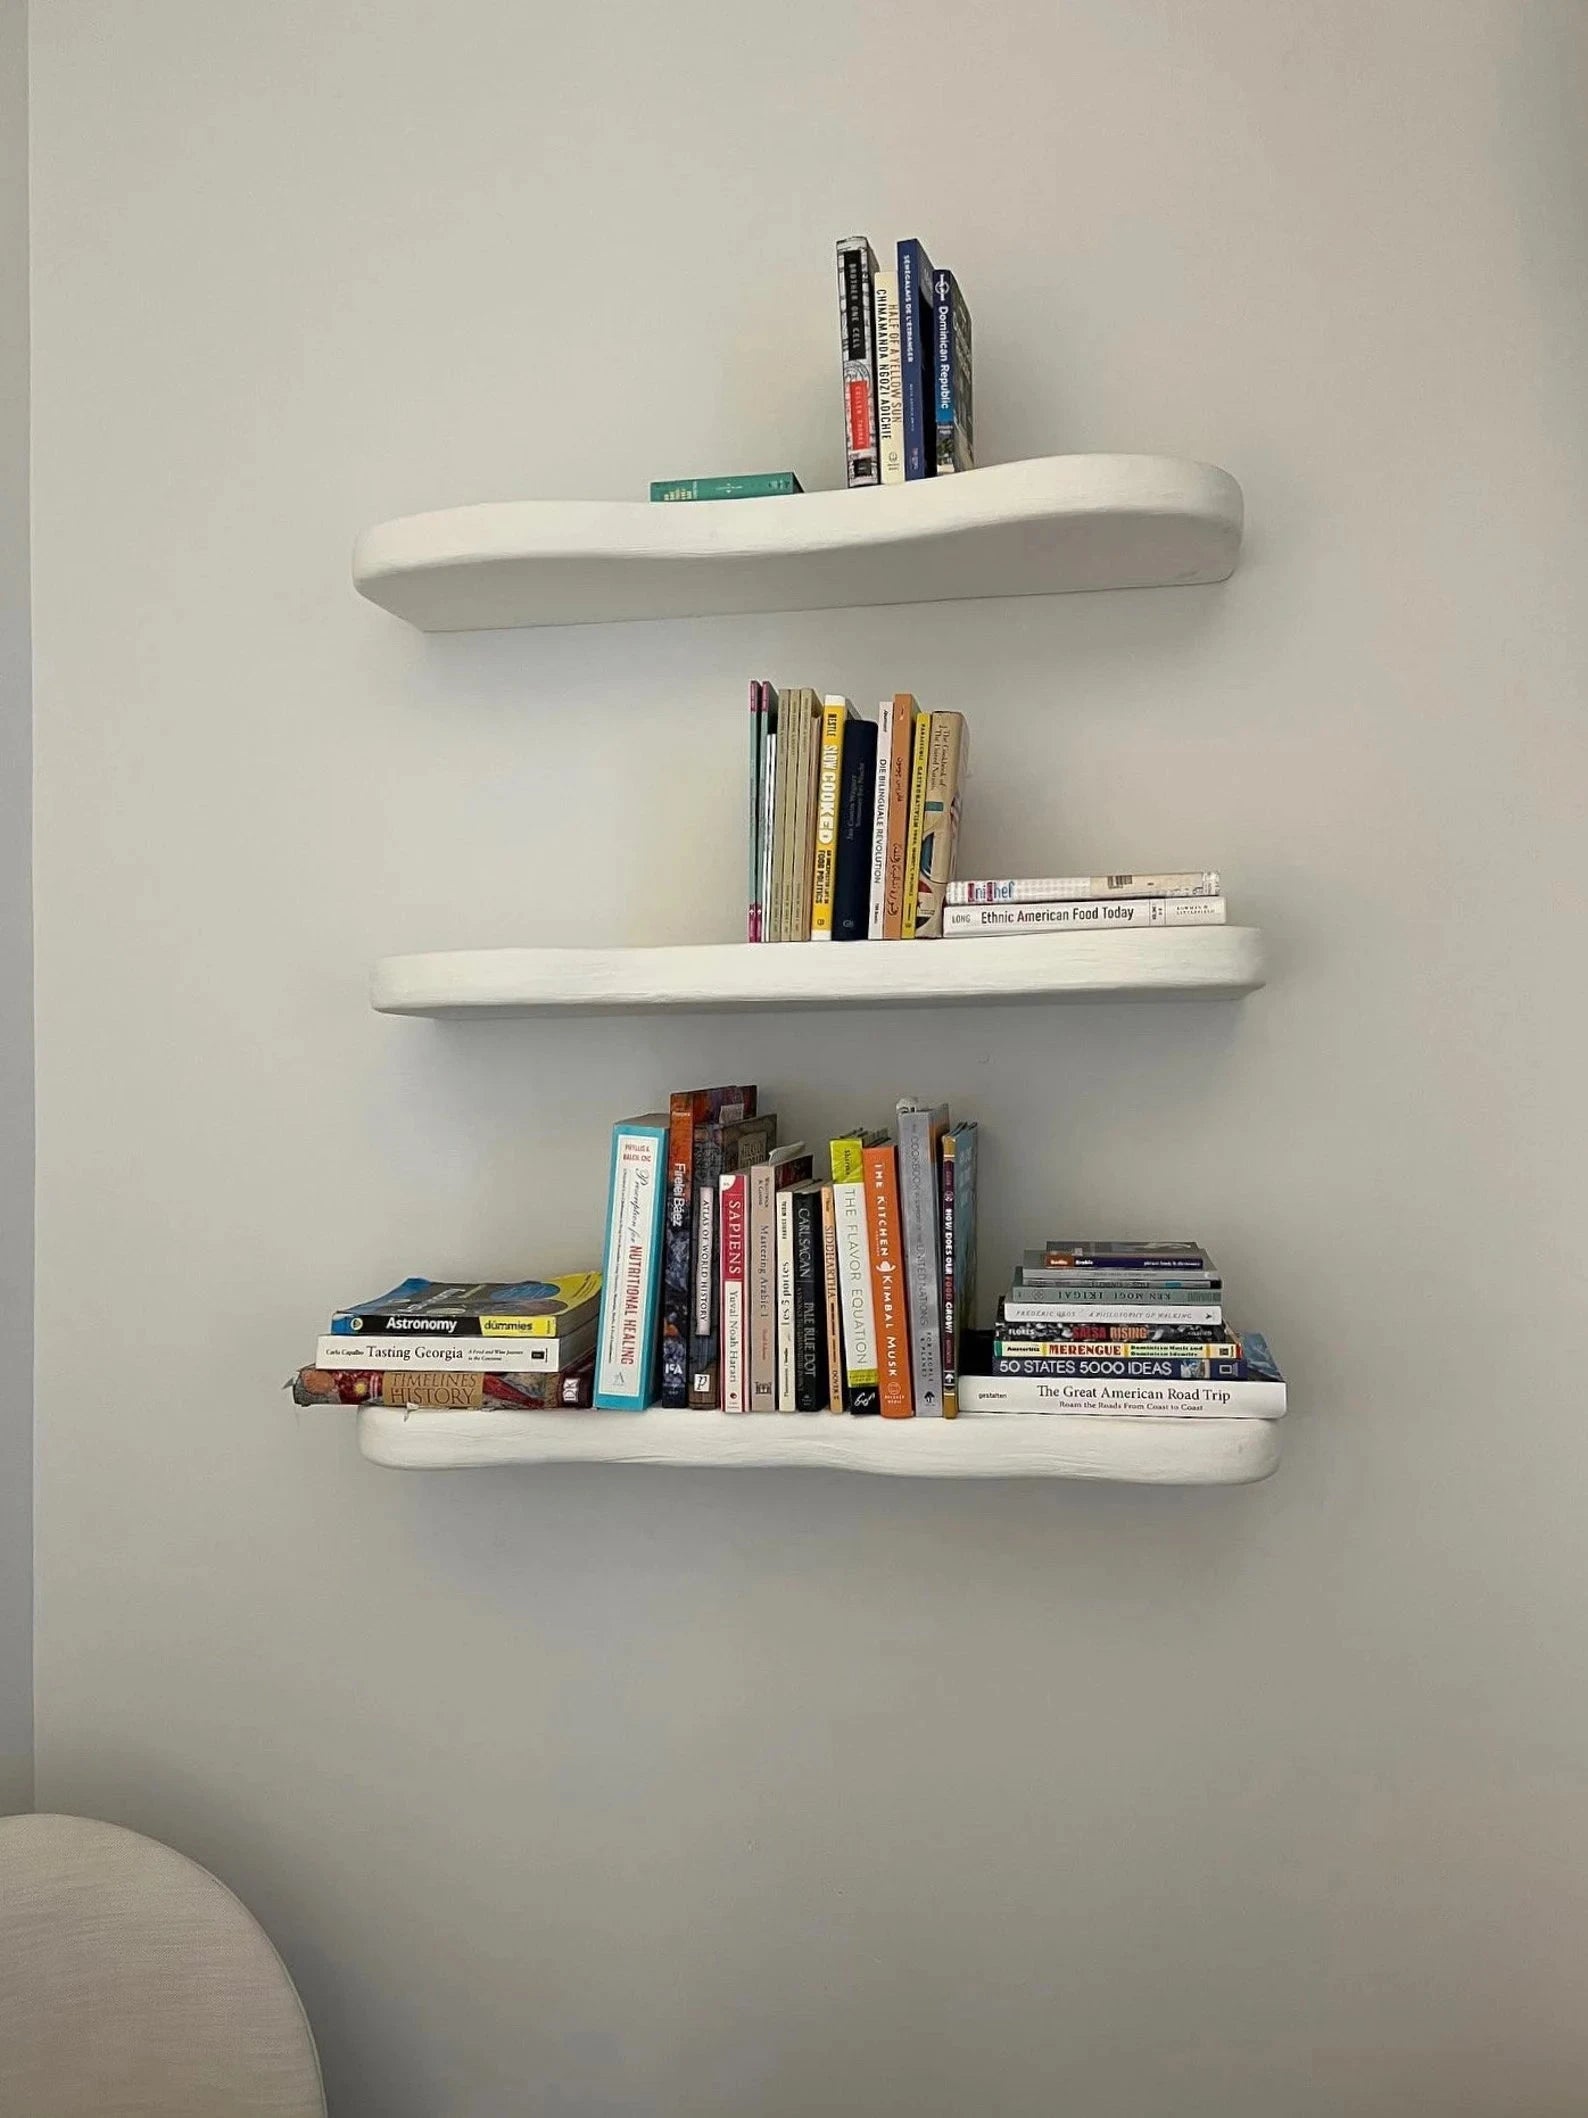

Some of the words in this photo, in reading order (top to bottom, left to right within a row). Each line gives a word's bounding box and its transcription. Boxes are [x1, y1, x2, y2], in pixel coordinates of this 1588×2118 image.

[851, 305, 859, 322] ONE
[876, 289, 888, 359] CHIMAMANDA
[888, 304, 899, 327] HALF
[852, 327, 860, 348] CELL
[889, 332, 899, 344] OF
[939, 306, 949, 361] Dominican
[879, 364, 890, 395] NGOZI
[890, 358, 901, 398] YELLOW
[939, 364, 950, 409] Republic
[880, 399, 891, 439] ADICHIE
[891, 402, 902, 423] SUN
[827, 714, 837, 736] NESTLE
[934, 730, 942, 742] The
[942, 730, 951, 742] The
[823, 745, 838, 770] SLOW
[879, 759, 887, 773] DIE
[932, 744, 941, 764] United
[940, 744, 950, 776] Cookbook
[819, 771, 836, 844] COOKED
[876, 776, 886, 826] BILINGUALE
[818, 850, 826, 869] FOOD
[874, 829, 884, 883] REVOLUTION
[815, 870, 825, 903] POLITICS
[952, 914, 971, 924] LONG
[981, 910, 1014, 924] Ethnic
[1017, 908, 1069, 923] American
[1073, 906, 1099, 921] Food
[1102, 905, 1134, 921] Today
[910, 1135, 921, 1190] COOKBOOK
[673, 1163, 686, 1196] Firelei
[874, 1163, 884, 1188] THE
[630, 1168, 649, 1227] Prescription
[845, 1189, 857, 1217] THE
[672, 1198, 686, 1226] Báez
[702, 1199, 710, 1226] ATLAS
[798, 1208, 810, 1236] CARL
[945, 1208, 953, 1230] HOW
[628, 1228, 641, 1243] for
[702, 1229, 710, 1241] OF
[728, 1200, 741, 1274] SAPIENS
[877, 1196, 889, 1256] KITCHEN
[758, 1225, 769, 1274] Mastering
[847, 1225, 864, 1280] FLAVOR
[945, 1232, 953, 1255] DOES
[701, 1244, 709, 1278] WORLD
[799, 1238, 811, 1278] SAGAN
[825, 1225, 836, 1299] SIDDHARTHA
[916, 1245, 927, 1281] UNITED
[945, 1257, 953, 1274] OUR
[624, 1245, 643, 1315] NUTRITIONAL
[781, 1261, 791, 1297] portes
[945, 1276, 953, 1300] FOOD
[700, 1281, 708, 1322] HISTORY
[729, 1290, 739, 1317] Yuval
[760, 1277, 769, 1309] Arabic
[883, 1272, 894, 1328] KIMBAL
[918, 1283, 928, 1326] NATIONS
[1057, 1291, 1103, 1300] IKIGAI
[1114, 1292, 1143, 1300] MOGI
[1149, 1292, 1171, 1300] KEN
[386, 1317, 458, 1334] Astronomy
[803, 1302, 815, 1324] PALE
[729, 1321, 739, 1347] Noah
[804, 1327, 815, 1351] BLUE
[851, 1289, 868, 1364] EQUATION
[1008, 1328, 1035, 1336] FLORES
[1072, 1327, 1106, 1339] SALSA
[1110, 1327, 1147, 1339] RISING
[366, 1345, 411, 1361] Tasting
[414, 1346, 463, 1361] Georgia
[621, 1319, 637, 1365] HEALING
[1049, 1344, 1121, 1355] MERENGUE
[729, 1350, 739, 1383] Harari
[804, 1353, 816, 1377] DOT
[886, 1336, 897, 1376] MUSK
[999, 1360, 1021, 1374] 50
[1024, 1360, 1075, 1374] STATES
[1079, 1361, 1125, 1374] 5000
[1128, 1361, 1172, 1375] IDEAS
[393, 1373, 477, 1387] TIMELINES
[563, 1378, 581, 1402] DK
[390, 1387, 474, 1404] HISTORY
[978, 1392, 1007, 1400] gestalten
[1037, 1385, 1059, 1398] The
[1063, 1385, 1096, 1399] Great
[1101, 1387, 1164, 1400] American
[1167, 1387, 1200, 1401] Road
[1202, 1389, 1231, 1403] Trip
